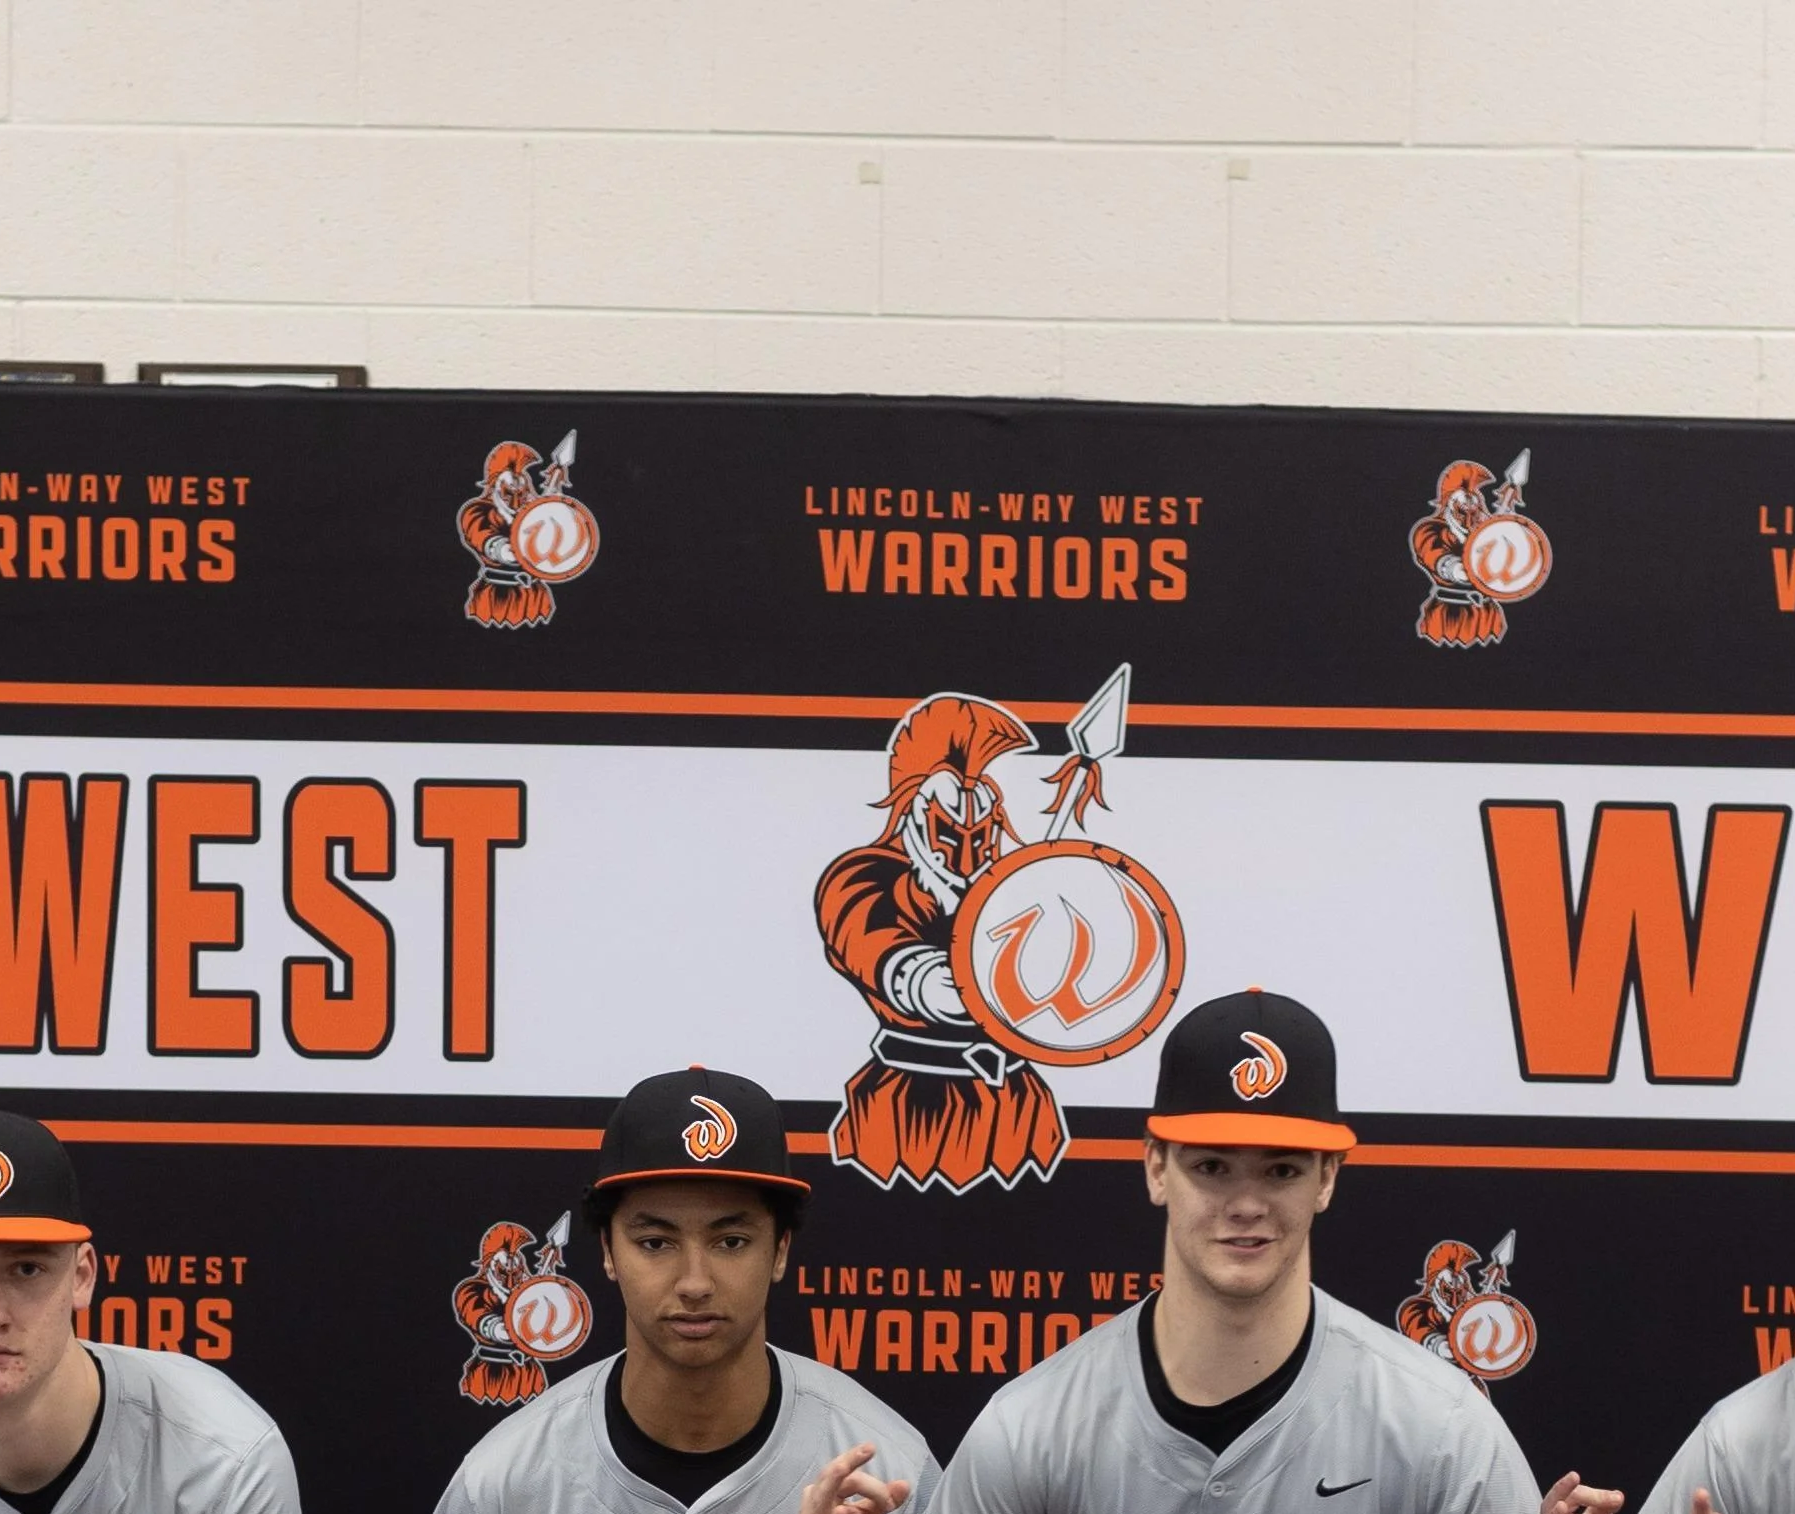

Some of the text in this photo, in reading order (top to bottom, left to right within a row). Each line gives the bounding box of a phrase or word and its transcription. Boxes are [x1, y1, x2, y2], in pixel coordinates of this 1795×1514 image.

[148, 477, 250, 505] WEST
[806, 488, 1202, 525] LINCOLN-WAY WEST
[819, 529, 1187, 602] WARRIORS
[146, 1256, 247, 1285] WEST
[798, 1266, 1164, 1300] LINCOLN-WAY WES
